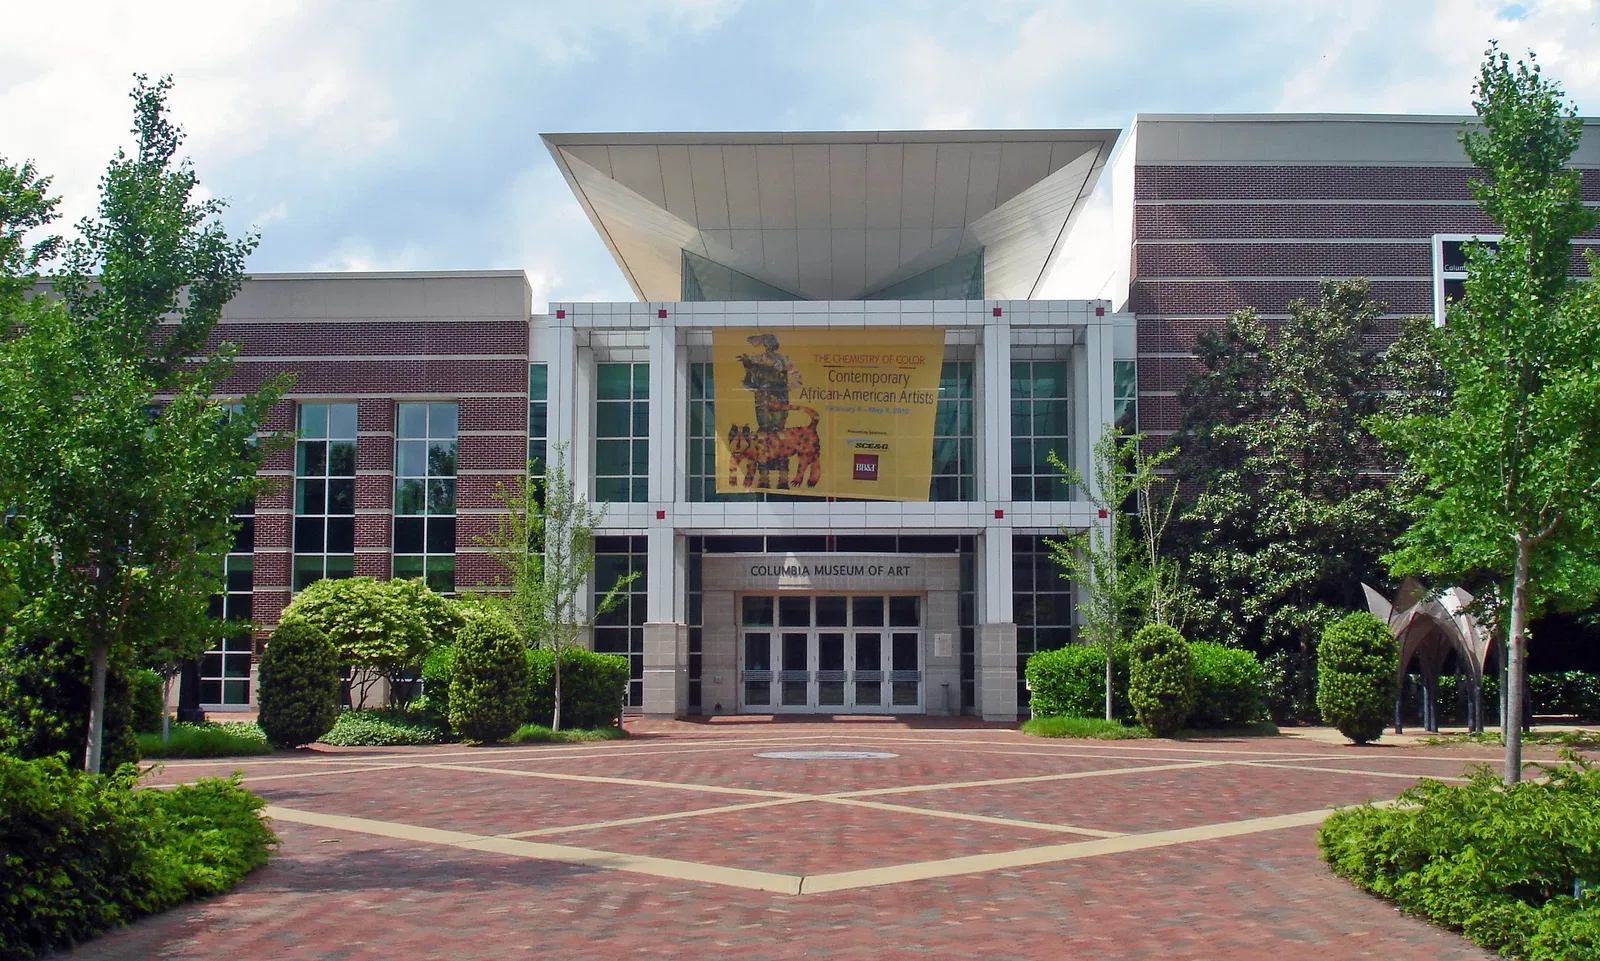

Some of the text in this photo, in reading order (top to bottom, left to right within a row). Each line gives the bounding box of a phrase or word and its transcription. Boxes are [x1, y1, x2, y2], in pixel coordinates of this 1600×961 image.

[813, 354, 926, 365] THE CHEMISTRY OF COLOR
[828, 369, 910, 389] Contemporary
[799, 387, 934, 405] African-American Artists
[856, 463, 876, 472] BB&T
[750, 565, 911, 577] COLUMBIA MUSEUM OF ART
